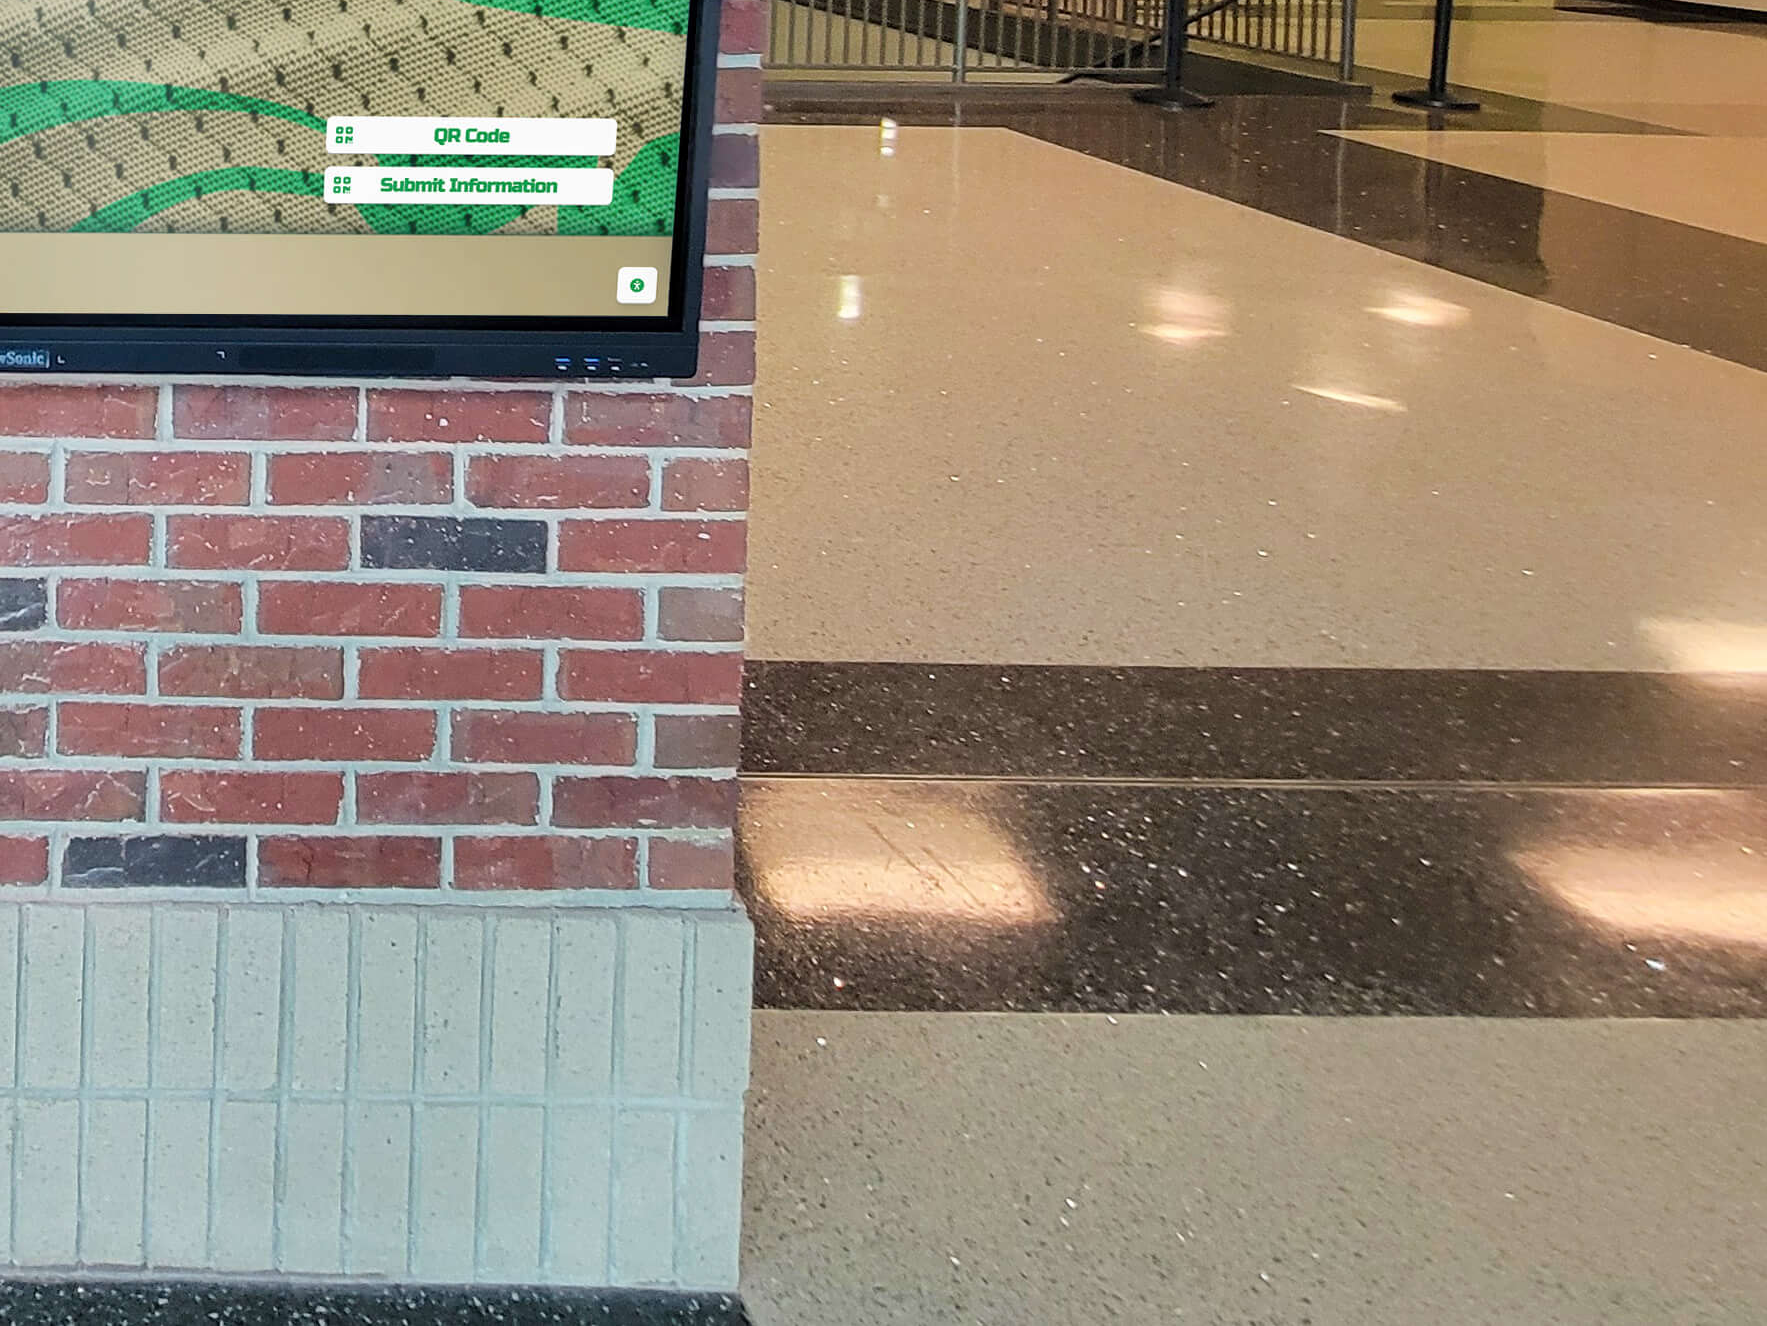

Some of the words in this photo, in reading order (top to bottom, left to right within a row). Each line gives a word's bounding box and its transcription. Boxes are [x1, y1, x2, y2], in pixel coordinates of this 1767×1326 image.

[433, 127, 461, 146] QR
[465, 128, 511, 144] Code
[380, 176, 446, 193] Submit
[449, 177, 558, 193] Information
